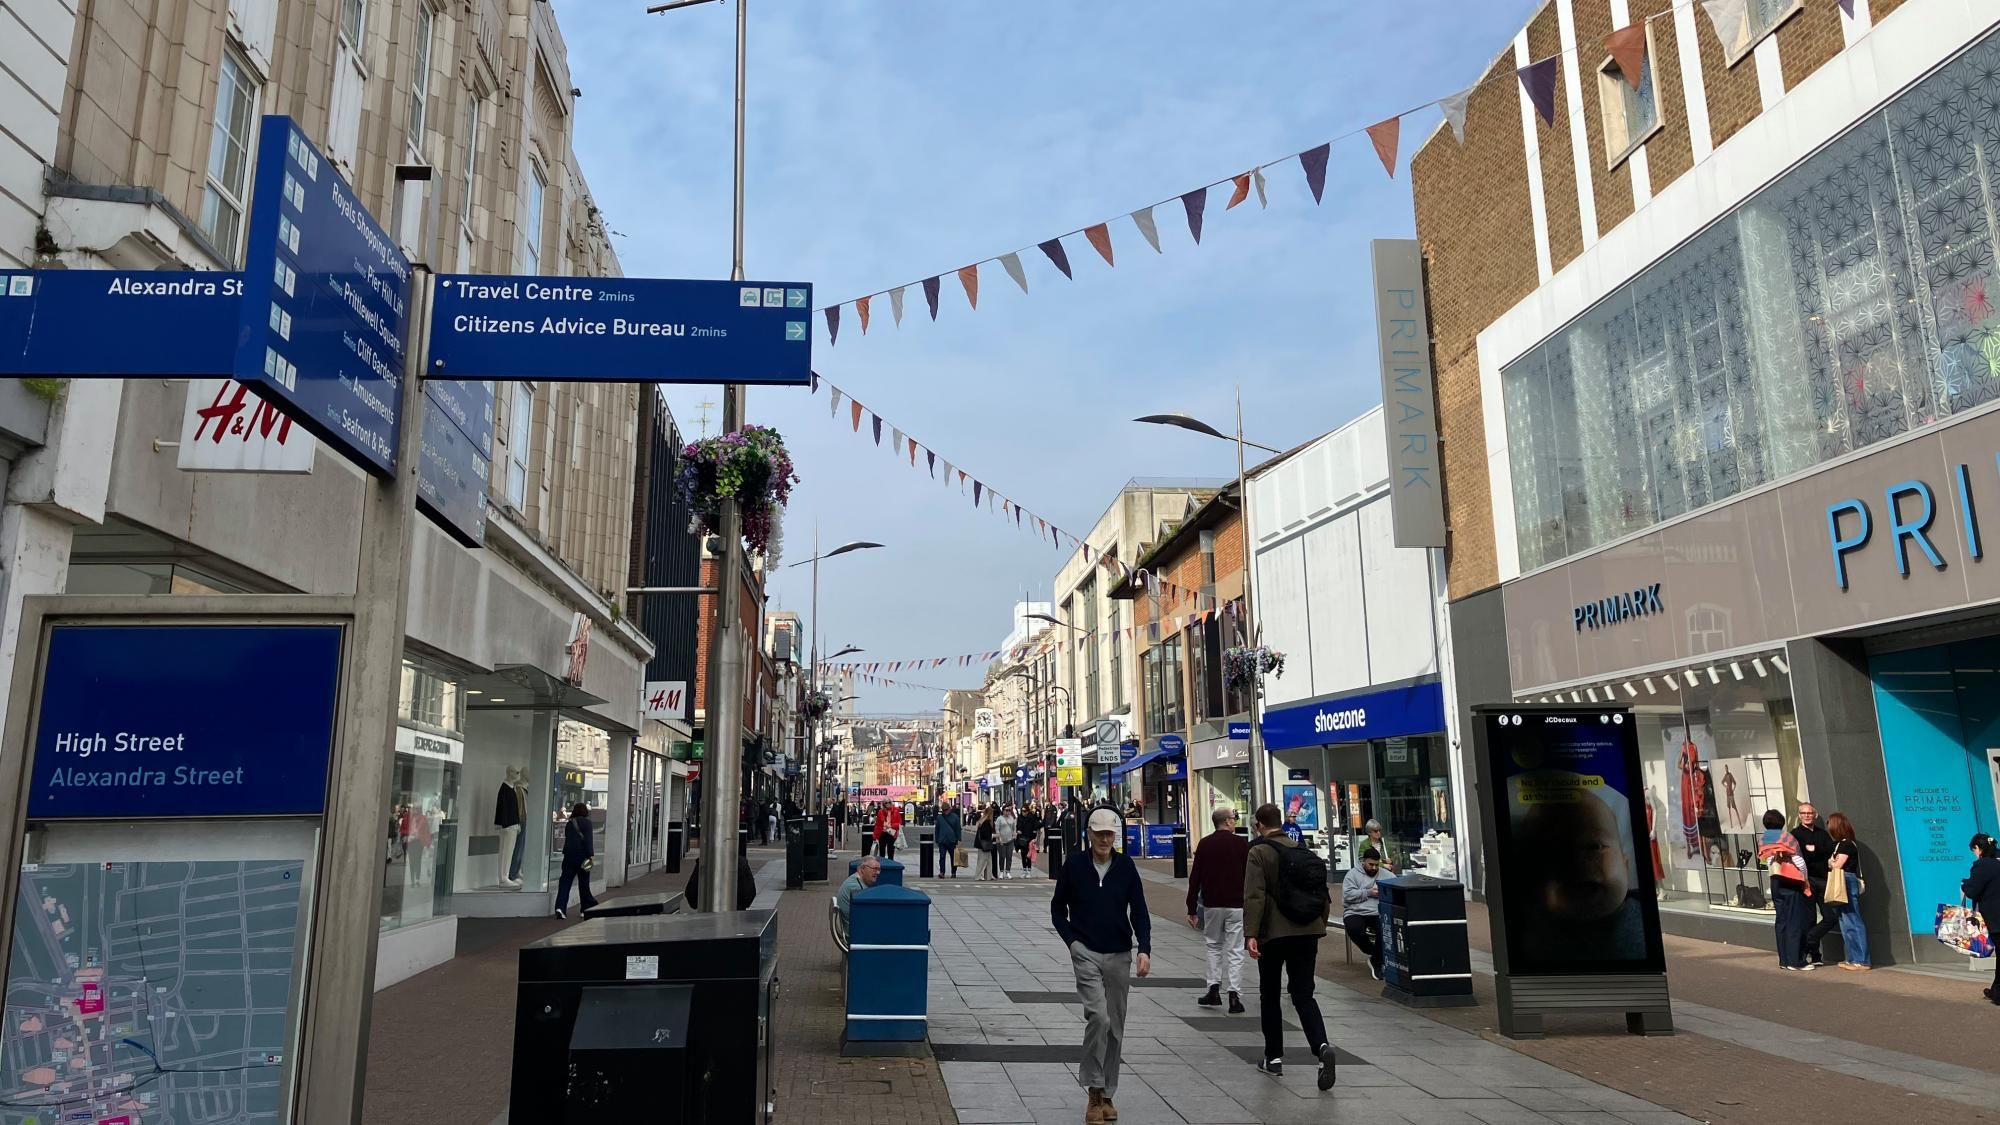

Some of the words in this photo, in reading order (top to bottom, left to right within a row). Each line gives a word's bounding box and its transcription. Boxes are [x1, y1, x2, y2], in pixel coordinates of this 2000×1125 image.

[332, 182, 356, 224] Royals
[357, 212, 386, 263] Shopping
[386, 248, 406, 283] Centre
[108, 277, 216, 296] Alexandra
[222, 278, 244, 296] St
[367, 265, 381, 293] Pier
[382, 280, 392, 308] Hill
[393, 295, 404, 319] Lift
[457, 281, 519, 300] Travel
[525, 283, 593, 301] Centre
[598, 290, 635, 302] 2mins
[344, 281, 379, 331] Prittlewell
[379, 319, 401, 353] Square
[454, 315, 534, 334] Citizens
[540, 317, 606, 335] Advice
[613, 319, 685, 337] Bureau
[691, 326, 727, 338] 2mins
[357, 338, 373, 365] Cliff
[372, 352, 397, 389] Gardens
[194, 380, 293, 445] H&M
[353, 376, 394, 425] Amusements
[1387, 289, 1432, 489] PRIMARK
[342, 409, 371, 447] Seafront
[371, 432, 377, 450] &
[377, 436, 392, 460] Pier
[1826, 451, 2000, 592] PRI
[1573, 583, 1664, 634] PRIMARK
[649, 689, 682, 711] H&M
[1315, 708, 1366, 733] shoezone
[55, 732, 107, 758] High
[114, 732, 185, 752] Street
[49, 766, 166, 787] Alexandra
[173, 765, 244, 786] Street
[1582, 778, 1599, 787] end
[1905, 795, 1960, 805] PRIMARK
